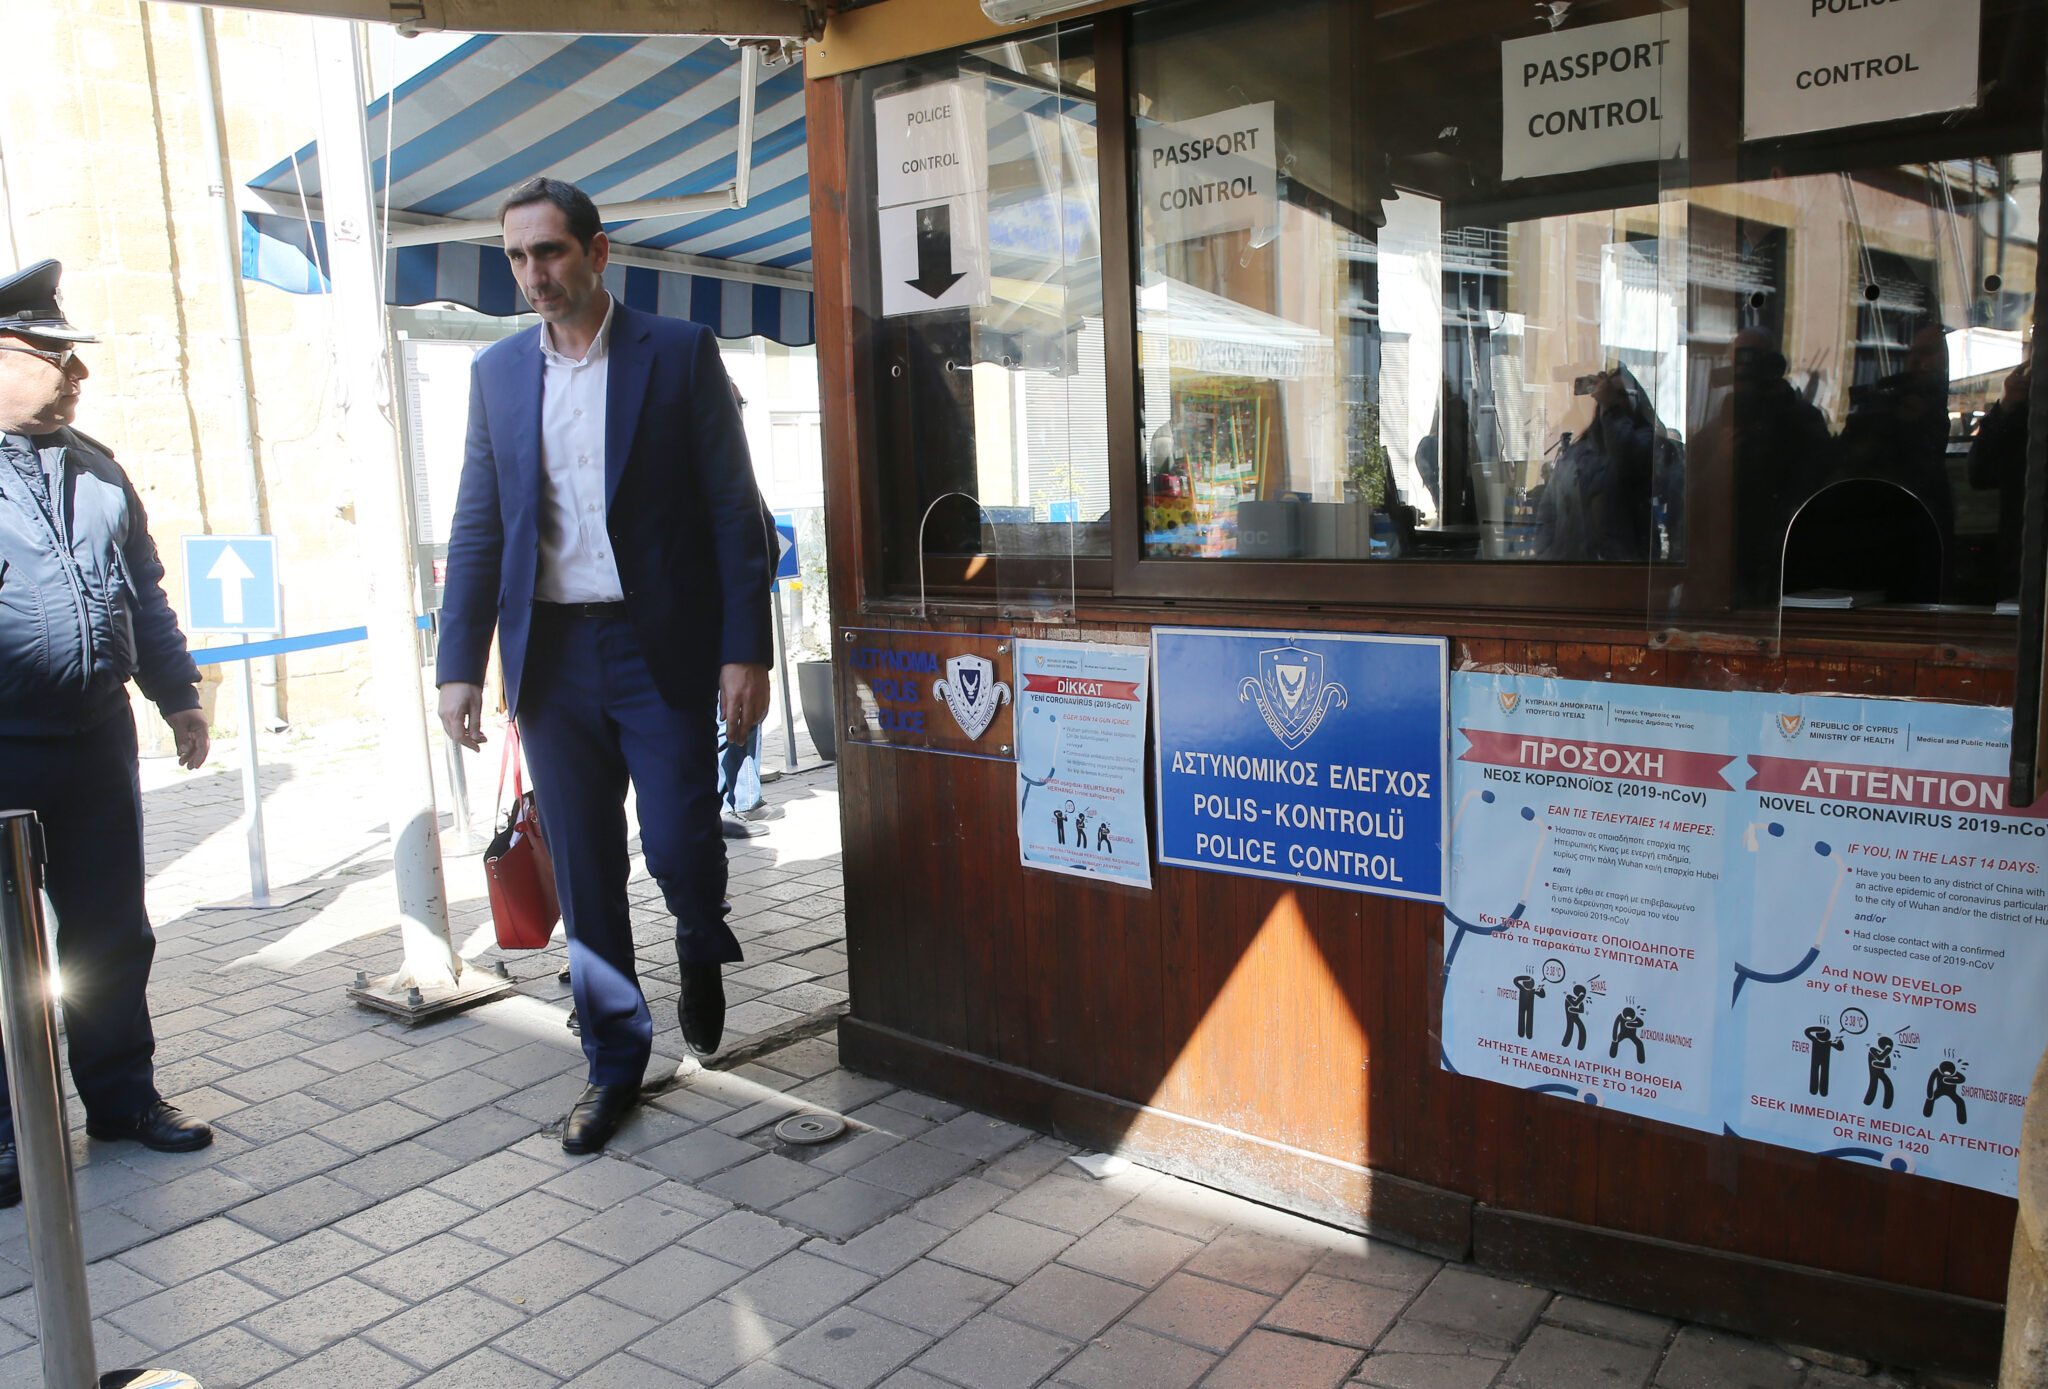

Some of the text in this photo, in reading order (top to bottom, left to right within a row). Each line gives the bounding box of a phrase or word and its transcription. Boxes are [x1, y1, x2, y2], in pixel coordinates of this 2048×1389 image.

[1523, 39, 1670, 87] PASSPORT
[1796, 53, 1919, 89] CONTROL
[907, 104, 951, 126] POLICE
[1527, 96, 1663, 138] CONTROL
[1152, 127, 1260, 169] PASSPORT
[901, 152, 959, 175] CONTROL
[1159, 175, 1257, 213] CONTROL
[850, 648, 939, 674] ΑΣΤΥΝΟΜΙΑ
[872, 676, 917, 702] POLİS
[1057, 678, 1103, 696] DİKKAT
[1094, 700, 1132, 711] (2019-nCoV)
[1257, 698, 1324, 740] ΑΣΤΥΝΟΜΙΑ ΚΥΠΡΟΥ
[1525, 699, 1603, 711] ΚΥΠΡΙΑΚΗ ΔΗΜΟΚΡΑΤΙΑ
[1525, 709, 1560, 717] ΥΠΟΥΡΓΕΙΟ
[869, 708, 925, 734] POLICE
[1810, 721, 1899, 734] REPUBLIC OF CYPRUS
[1809, 732, 1894, 745] MINISTRY OF HEALTH
[1520, 740, 1663, 778] ΠΡΟΣΟΧΗ
[1172, 751, 1318, 787] ΑΣΤΥΝΟΜΙΚΟΣ
[1330, 765, 1431, 798] ΕΛΕΓΧΟΣ
[1483, 767, 1707, 808] ΝΕΟΣ ΚΟΡΩΝΟΪΟΣ (2019-nCoV)
[1800, 766, 2004, 810] ATTENTION
[1548, 805, 1716, 836] ΕΑΝ ΤΙΣ ΤΕΛΕΥΤΑΙΕΣ 14 ΜΕΡΕΣ:
[1760, 796, 2048, 837] NOVEL CORONAVIRUS 2019-nCo
[1197, 833, 1403, 882] POLICE CONTROL
[1620, 848, 1629, 856] με
[1678, 844, 1691, 853] της
[1848, 843, 2040, 874] IF YOU, IN THE LAST 14 DAYS:
[1579, 855, 1595, 863] στην
[1618, 858, 1643, 869] Wuhan
[1696, 871, 1719, 880] Hubei
[1856, 868, 2045, 897] Have you been to any district of China with
[1856, 882, 2001, 906] an active epidemic of coronavirus
[1590, 911, 1630, 925] 2019-nCoV
[1648, 910, 1659, 918] του
[1855, 894, 2033, 924] to the city of Wuhan and/or the district of
[1855, 912, 1887, 923] and/or
[1479, 913, 1695, 960] Και ΤΩΡΑ εμφανίσατε ΟΠΟΙΟΔΗΠΟΤΕ
[1491, 929, 1679, 971] από τα παρακάτω ΣΥΜΠΤΩΜΑΤΑ
[1854, 930, 1871, 940] Had
[1873, 933, 1896, 943] close
[1898, 936, 1929, 948] contact
[1931, 941, 1949, 951] with
[1960, 945, 2005, 958] confirmed
[1864, 945, 1907, 958] suspected
[1909, 952, 1930, 962] case
[1932, 954, 1942, 963] of
[1944, 955, 1995, 970] 2019-nCoV
[1822, 965, 1962, 996] And NOW DEVELOP
[1806, 979, 1977, 1014] any of these SYMPTOMS
[1792, 1033, 1920, 1054] FEVER COUGH
[1477, 1038, 1682, 1091] ΖΗΤΗΣΤΕ ΑΜΕΣΑ ΙΑΤΡΙΚΗ ΒΟΗΘΕΙΑ
[1513, 1058, 1657, 1099] ΤΗΛΕΦΩΝΗΣΤΕ ΣΤΟ 1420
[1961, 1085, 2028, 1107] SHORTNESS OF BREA
[1750, 1094, 1786, 1112] SEEK
[1790, 1104, 1866, 1128] IMMEDIATE
[1870, 1119, 1936, 1142] MEDICAL
[1833, 1126, 1929, 1155] OR RING 1420
